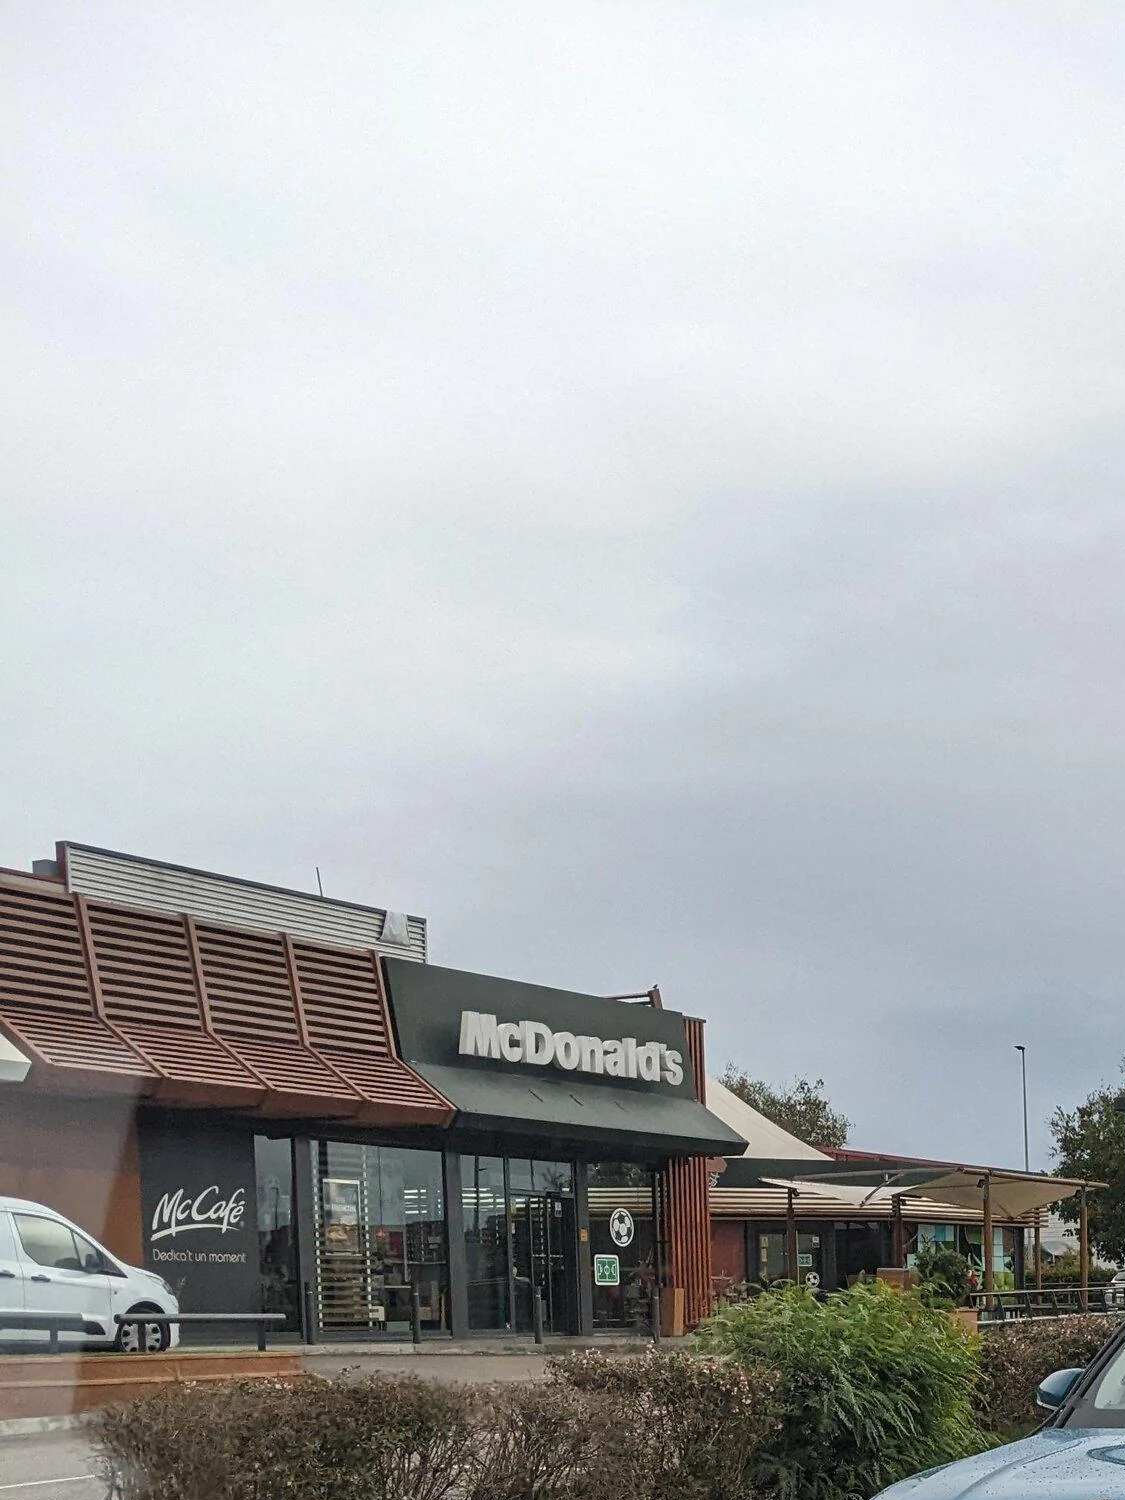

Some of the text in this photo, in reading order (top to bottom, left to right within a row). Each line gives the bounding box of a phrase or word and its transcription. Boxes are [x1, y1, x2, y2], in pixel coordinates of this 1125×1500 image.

[459, 1010, 684, 1086] McDonald's
[152, 1185, 245, 1237] McCafé
[153, 1248, 247, 1263] Dedica't un moment
